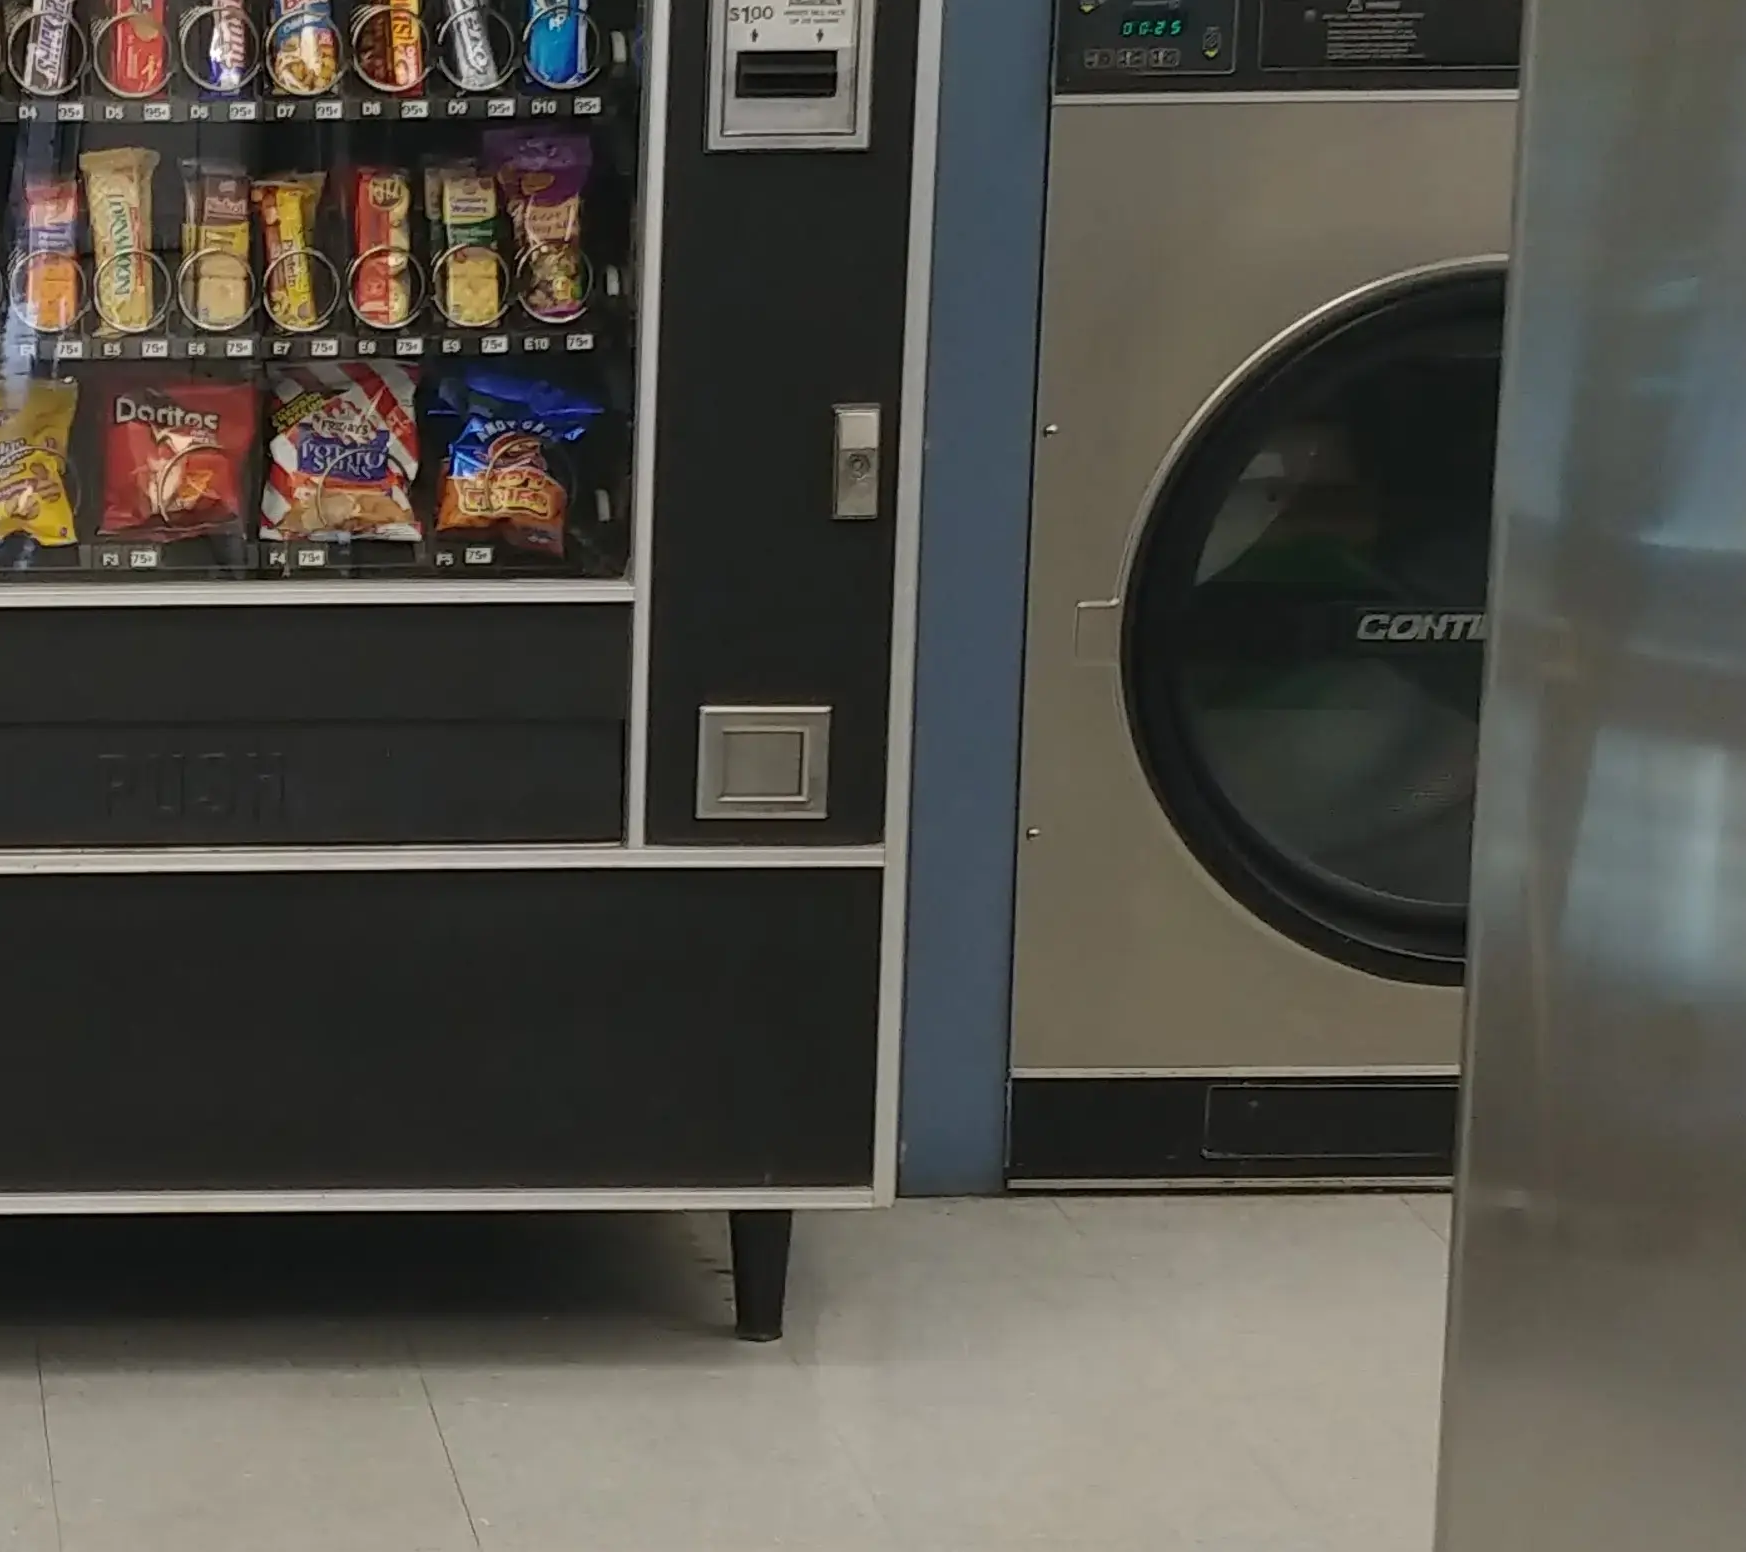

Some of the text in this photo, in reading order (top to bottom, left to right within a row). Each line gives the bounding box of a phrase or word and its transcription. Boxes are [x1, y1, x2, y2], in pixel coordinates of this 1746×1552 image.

[115, 397, 220, 431] Doritos
[1356, 613, 1488, 641] CONTI
[97, 751, 287, 820] PUSH
